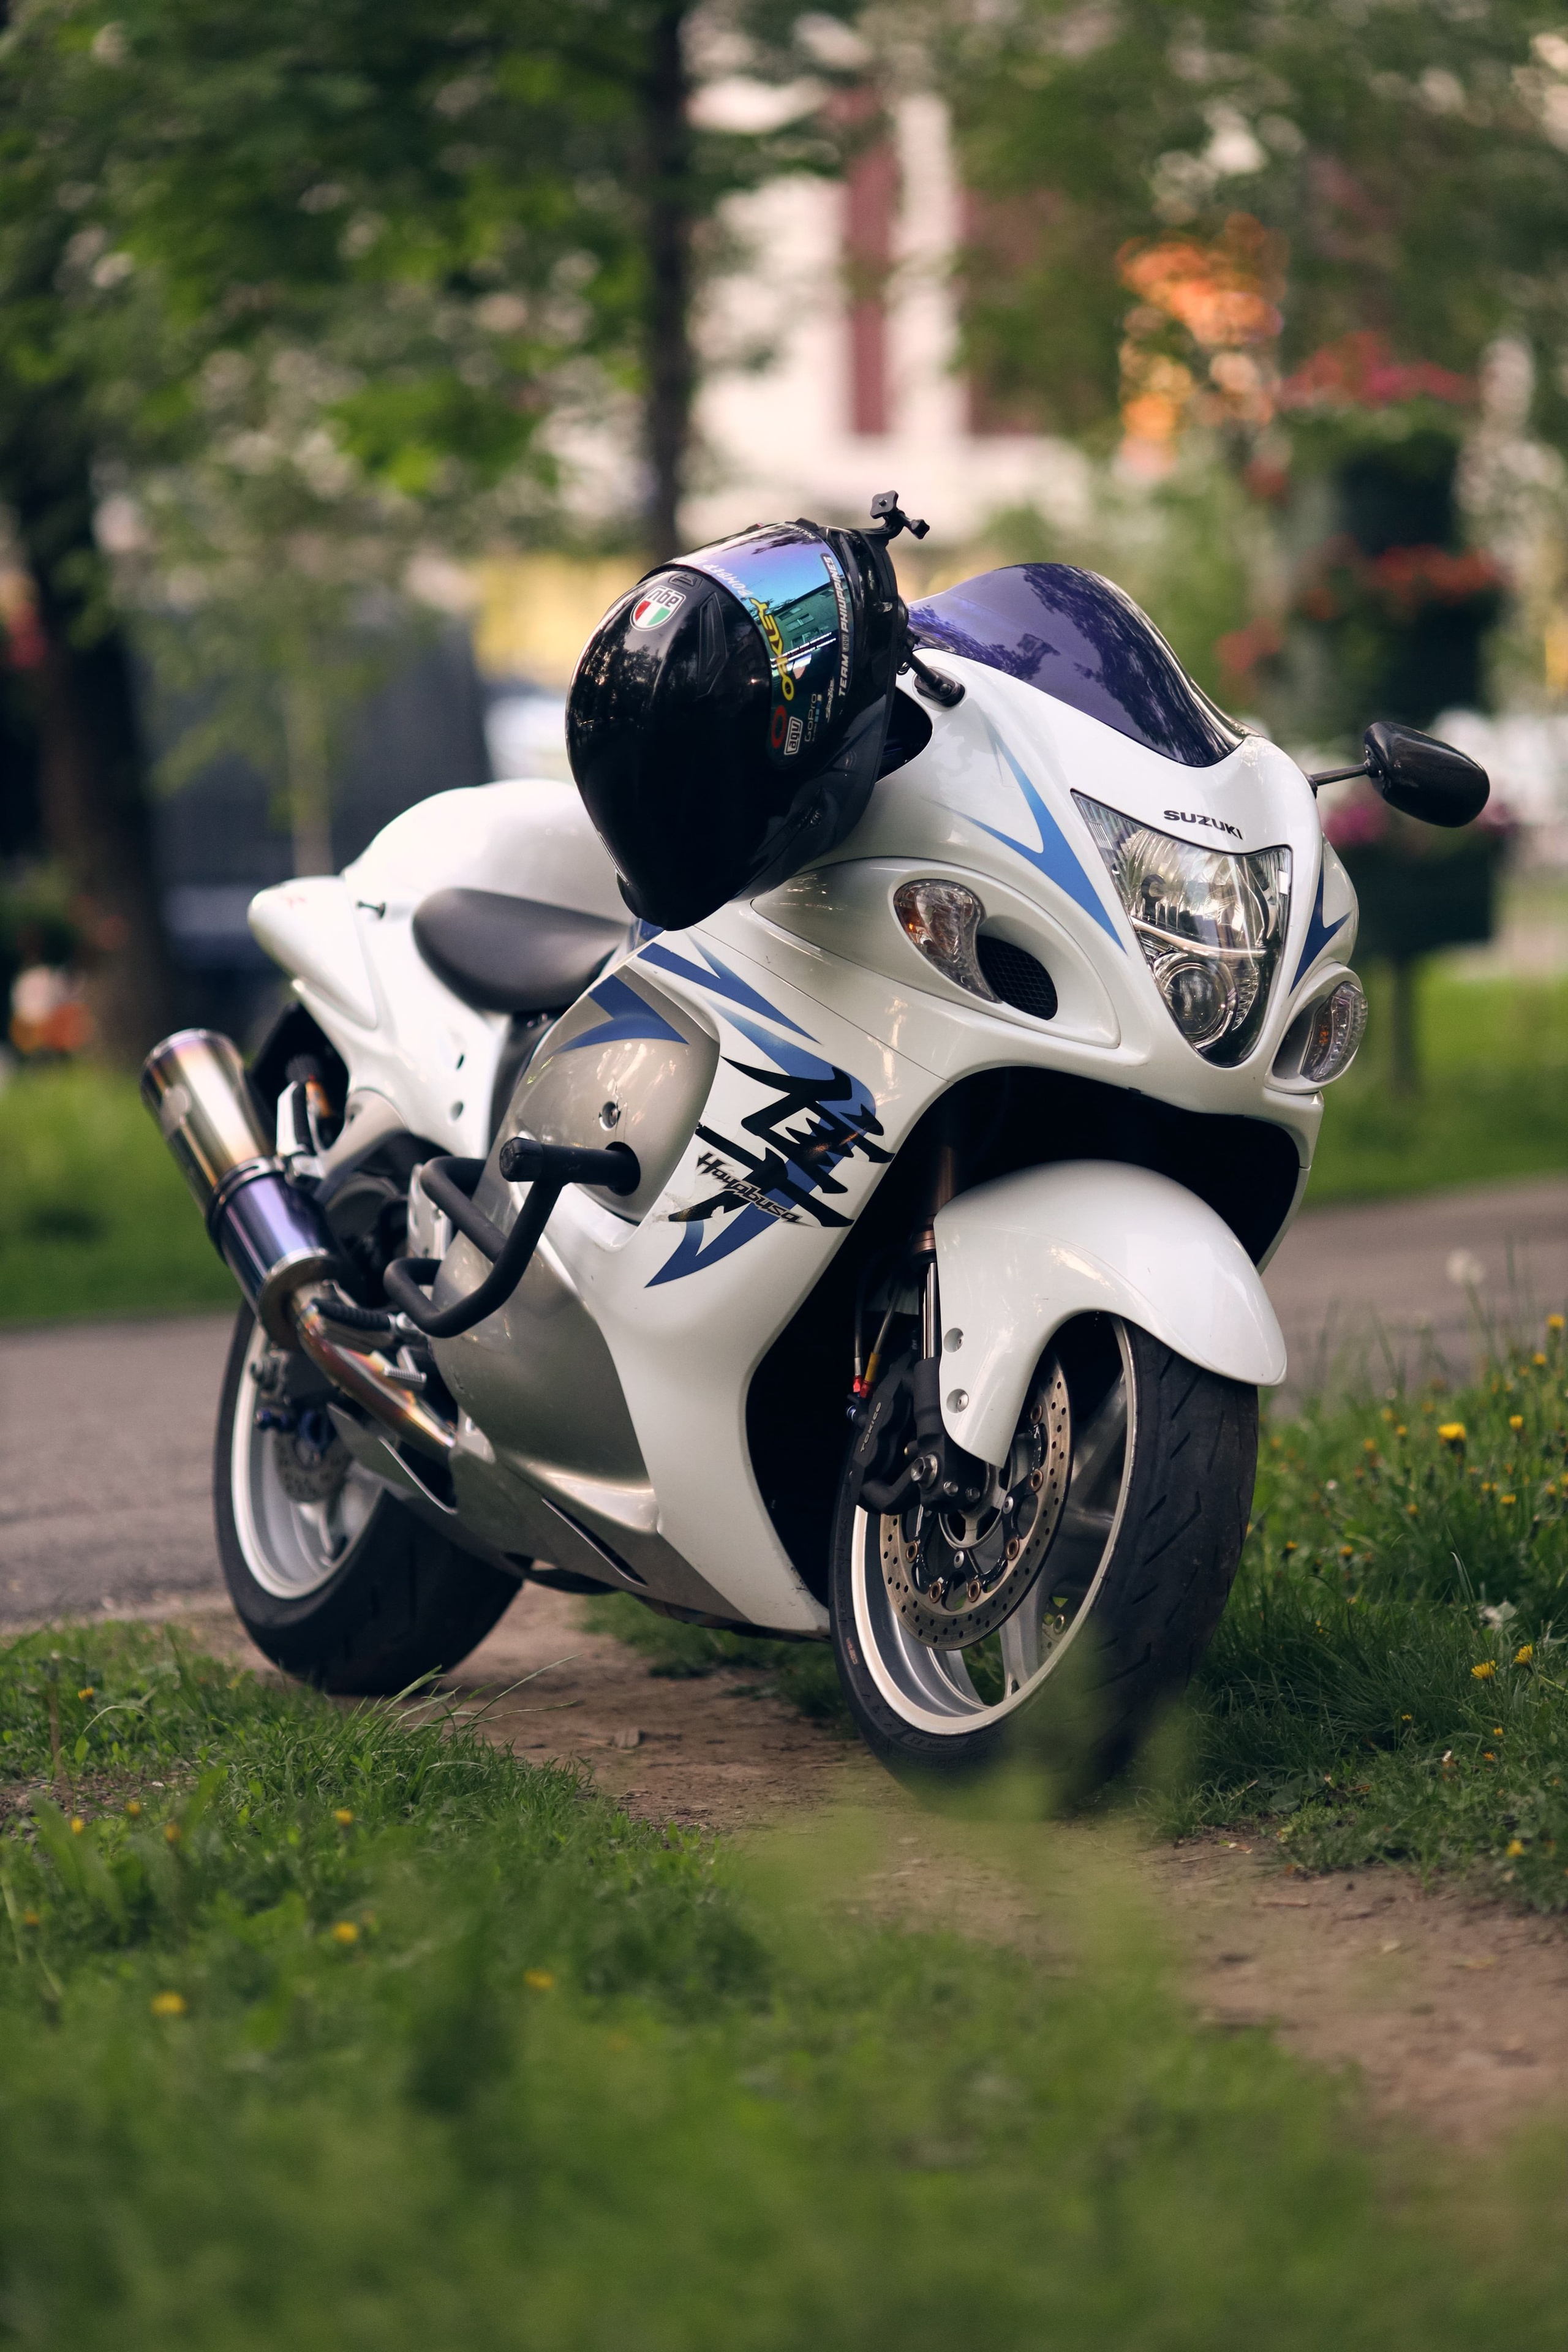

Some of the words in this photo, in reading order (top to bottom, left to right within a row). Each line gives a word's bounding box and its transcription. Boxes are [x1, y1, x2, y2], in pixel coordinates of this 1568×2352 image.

[647, 588, 680, 608] agv
[703, 563, 754, 598] BOMBER
[748, 597, 794, 701] OAKLEY
[838, 654, 850, 696] TEAM
[804, 693, 817, 742] GoPro
[1163, 810, 1243, 840] SUZUKI
[696, 1151, 810, 1226] Hayabusa
[860, 1402, 881, 1452] TOKICO
